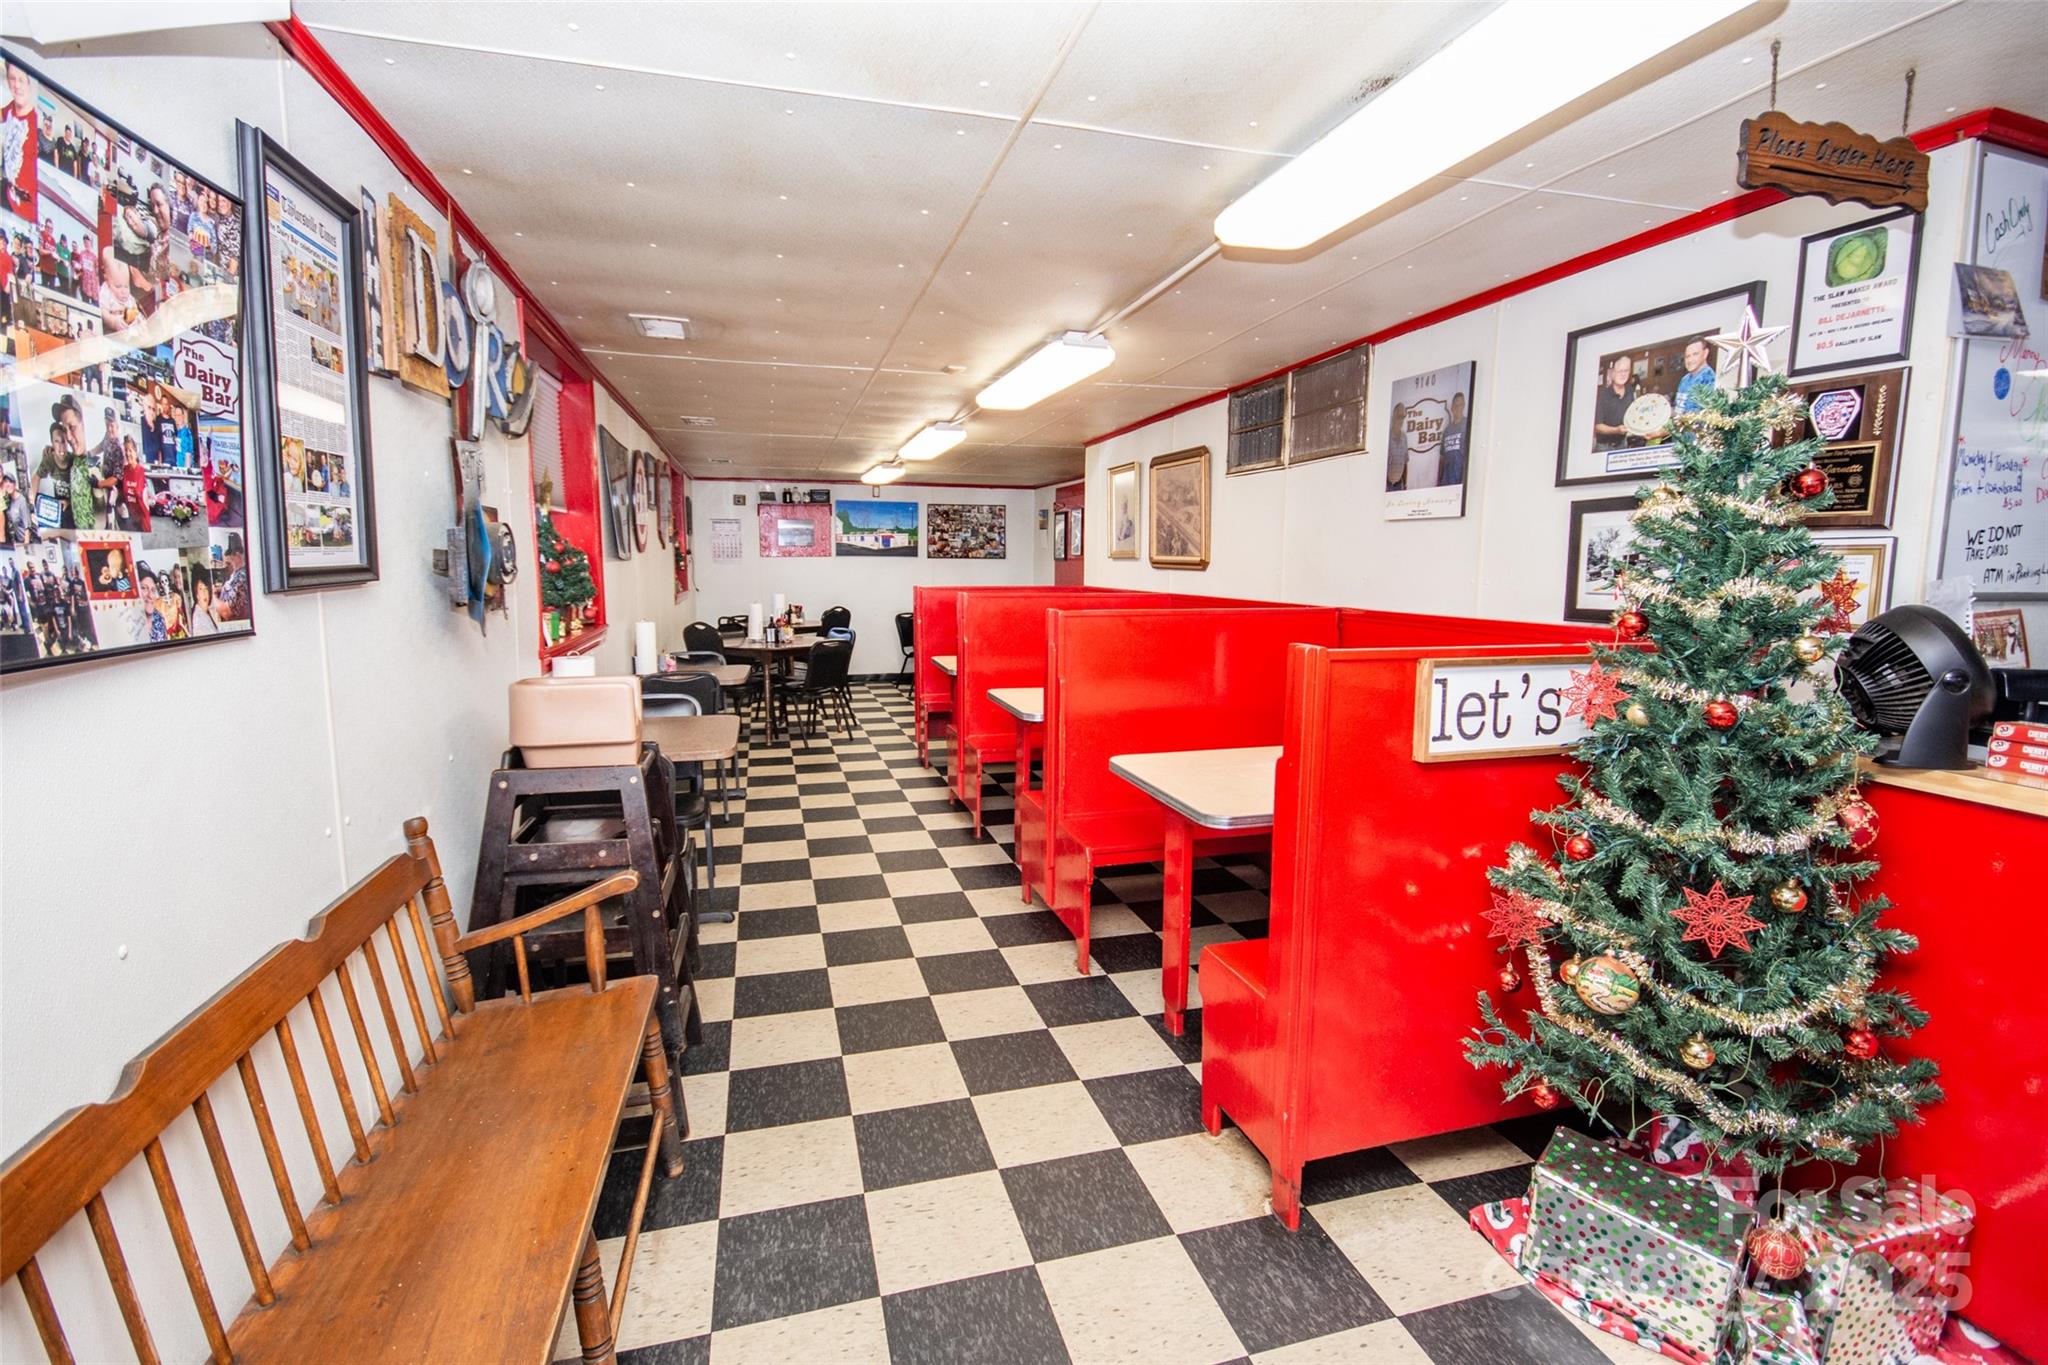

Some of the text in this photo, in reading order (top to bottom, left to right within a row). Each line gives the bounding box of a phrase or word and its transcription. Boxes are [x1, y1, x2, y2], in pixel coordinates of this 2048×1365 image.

[1816, 139, 1868, 167] Order
[1871, 149, 1916, 178] Here
[1985, 196, 2033, 254] Cash Only
[1813, 295, 1826, 303] THE
[1828, 290, 1845, 300] SLAW
[1872, 278, 1898, 290] AWARD
[183, 346, 205, 362] The
[184, 360, 231, 393] Dairy
[1414, 374, 1437, 390] 9140
[201, 384, 231, 407] Bar
[1408, 410, 1423, 419] The
[1407, 418, 1444, 433] Dairy
[1418, 431, 1443, 445] Bar
[1967, 524, 2023, 546] WE DO NOT
[1965, 544, 2008, 562] TAKE CARDS
[1983, 568, 2004, 584] ATM
[1431, 673, 1563, 742] let's
